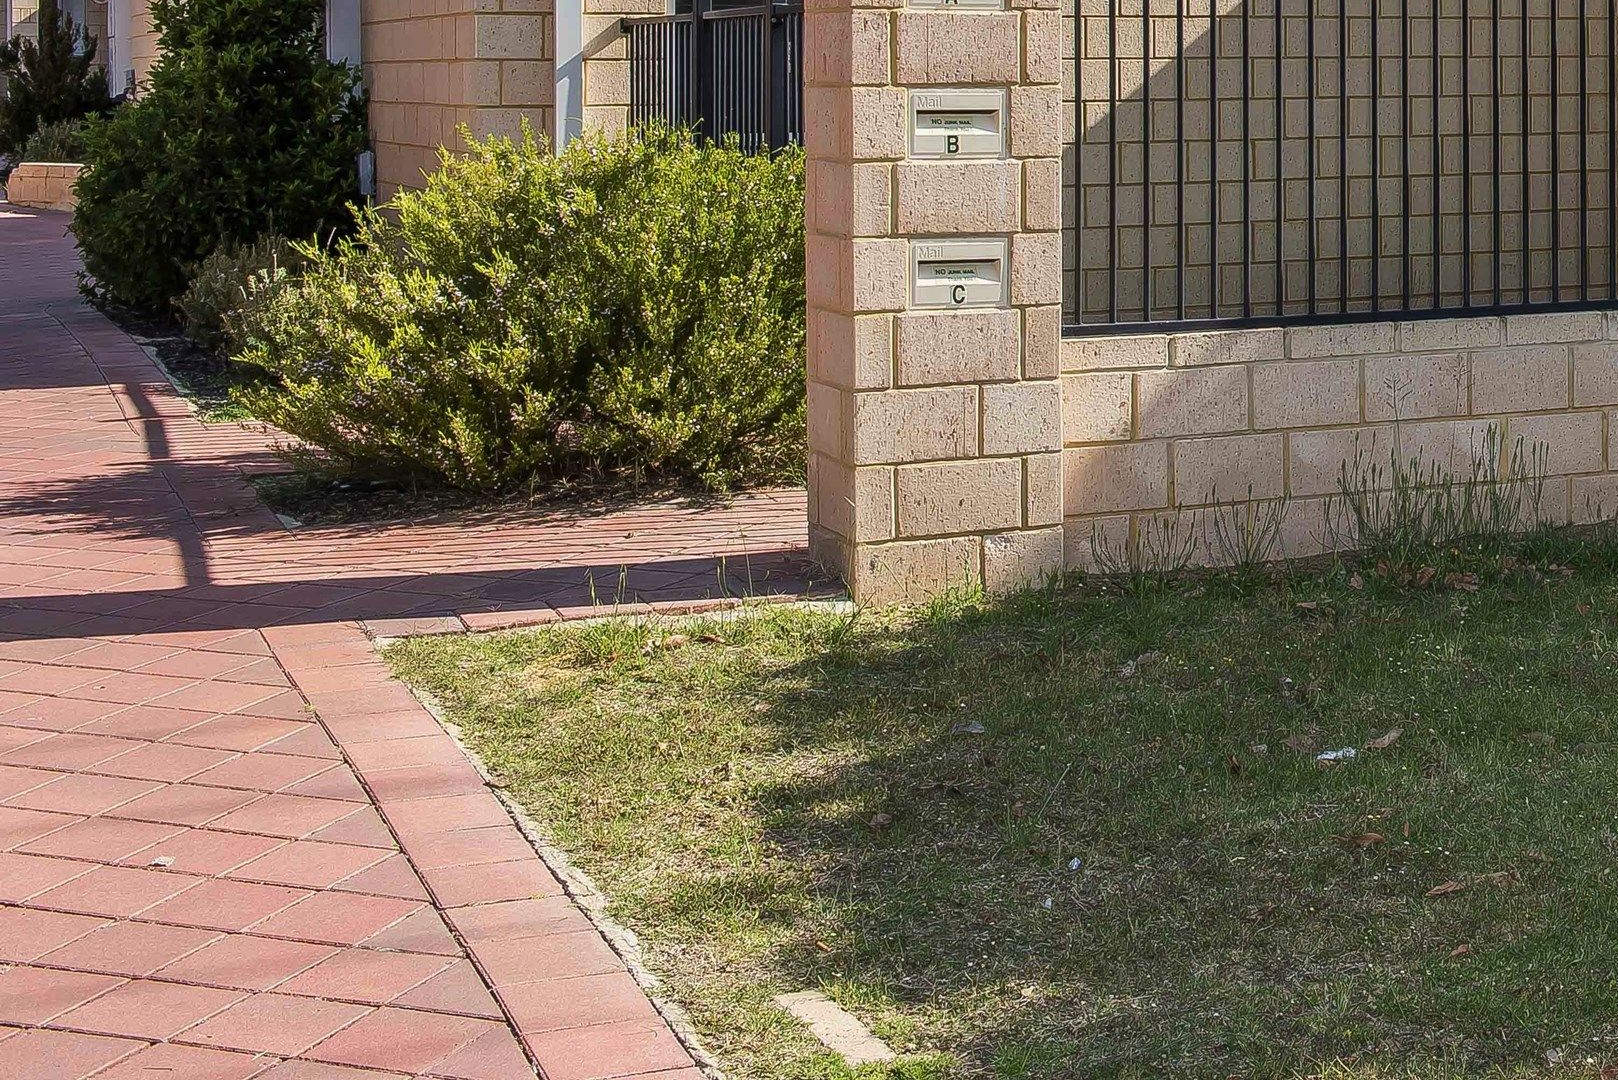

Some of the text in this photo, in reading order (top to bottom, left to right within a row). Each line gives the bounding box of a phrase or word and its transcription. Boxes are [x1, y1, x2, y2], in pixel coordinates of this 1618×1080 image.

[917, 95, 942, 108] Mail
[947, 135, 959, 153] B
[918, 245, 944, 258] Mail
[952, 284, 966, 304] C
